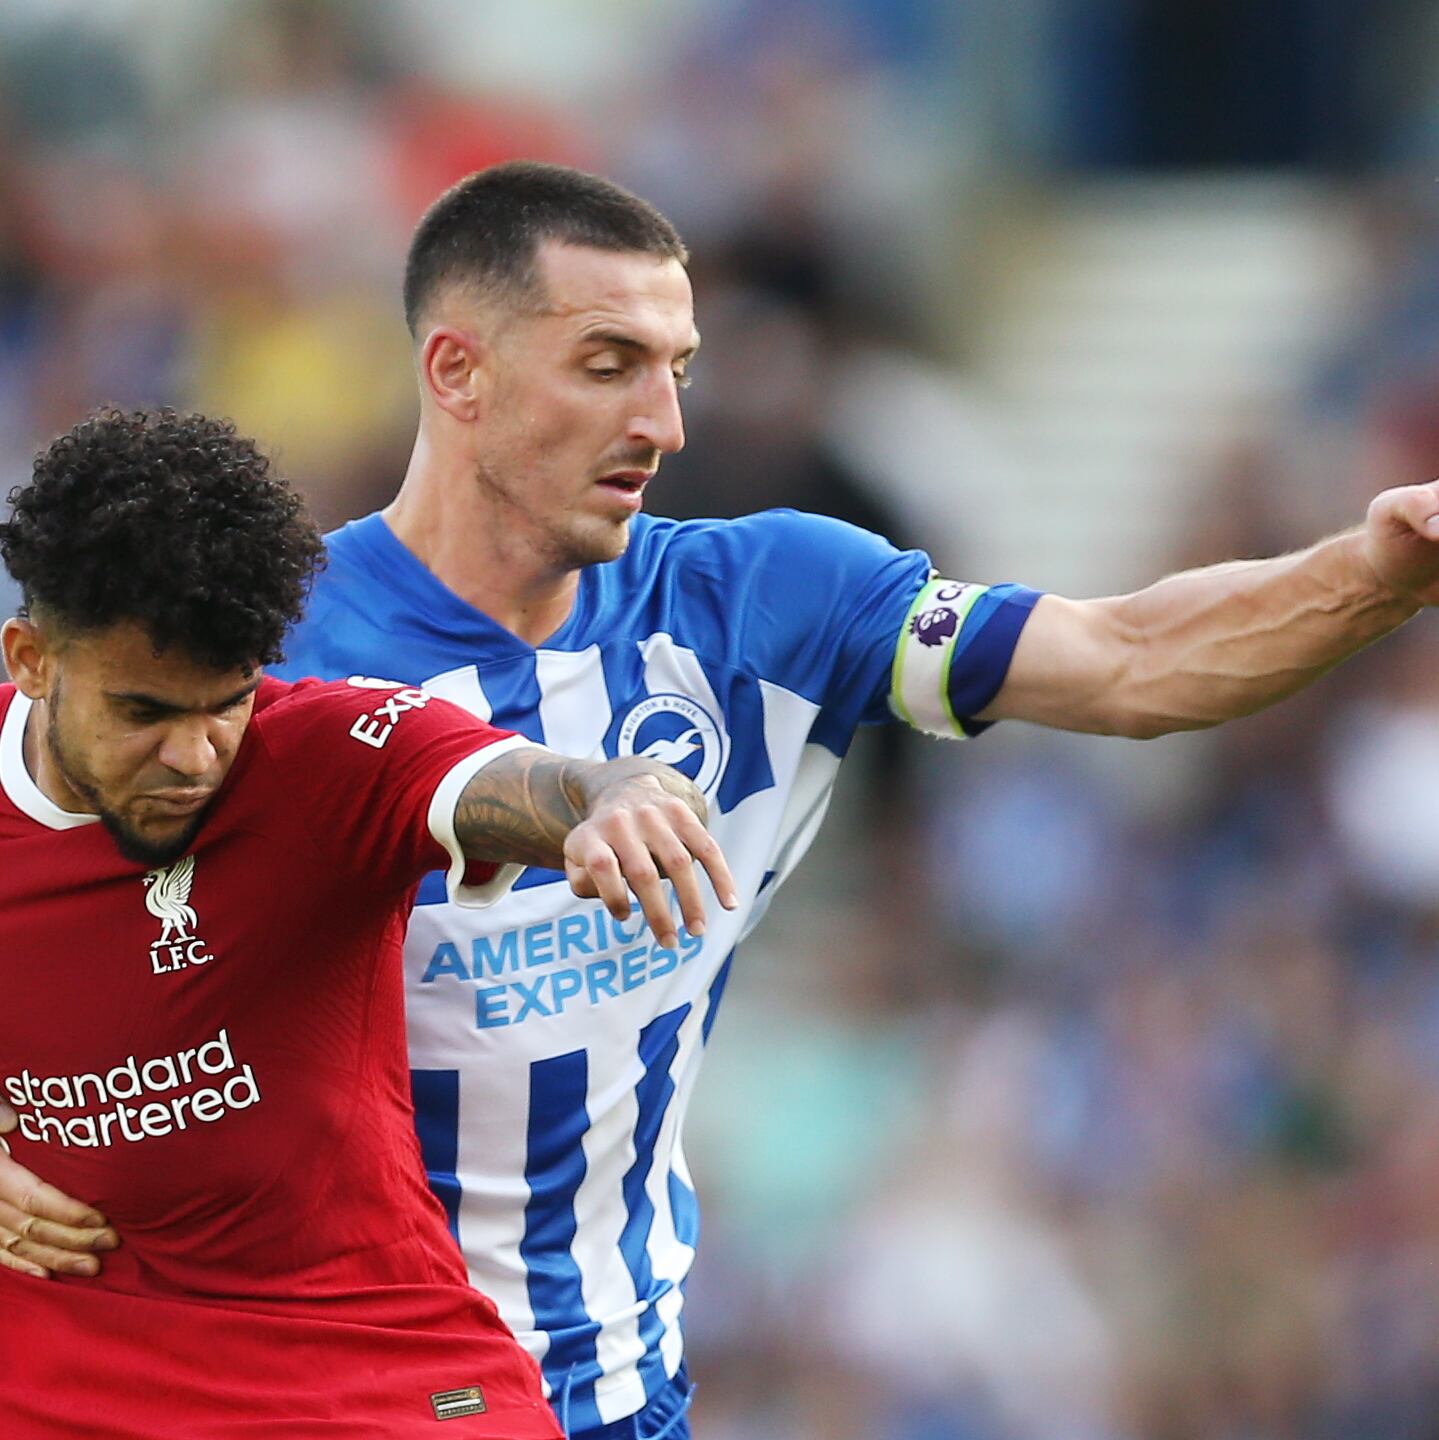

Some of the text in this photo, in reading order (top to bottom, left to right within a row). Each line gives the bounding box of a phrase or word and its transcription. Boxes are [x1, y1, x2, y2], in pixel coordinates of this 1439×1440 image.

[149, 940, 215, 975] L.F.C.
[421, 887, 680, 983] AMERIC
[475, 924, 704, 1029] EXPRESS
[4, 1028, 235, 1108] standard
[19, 1063, 261, 1148] chartered
